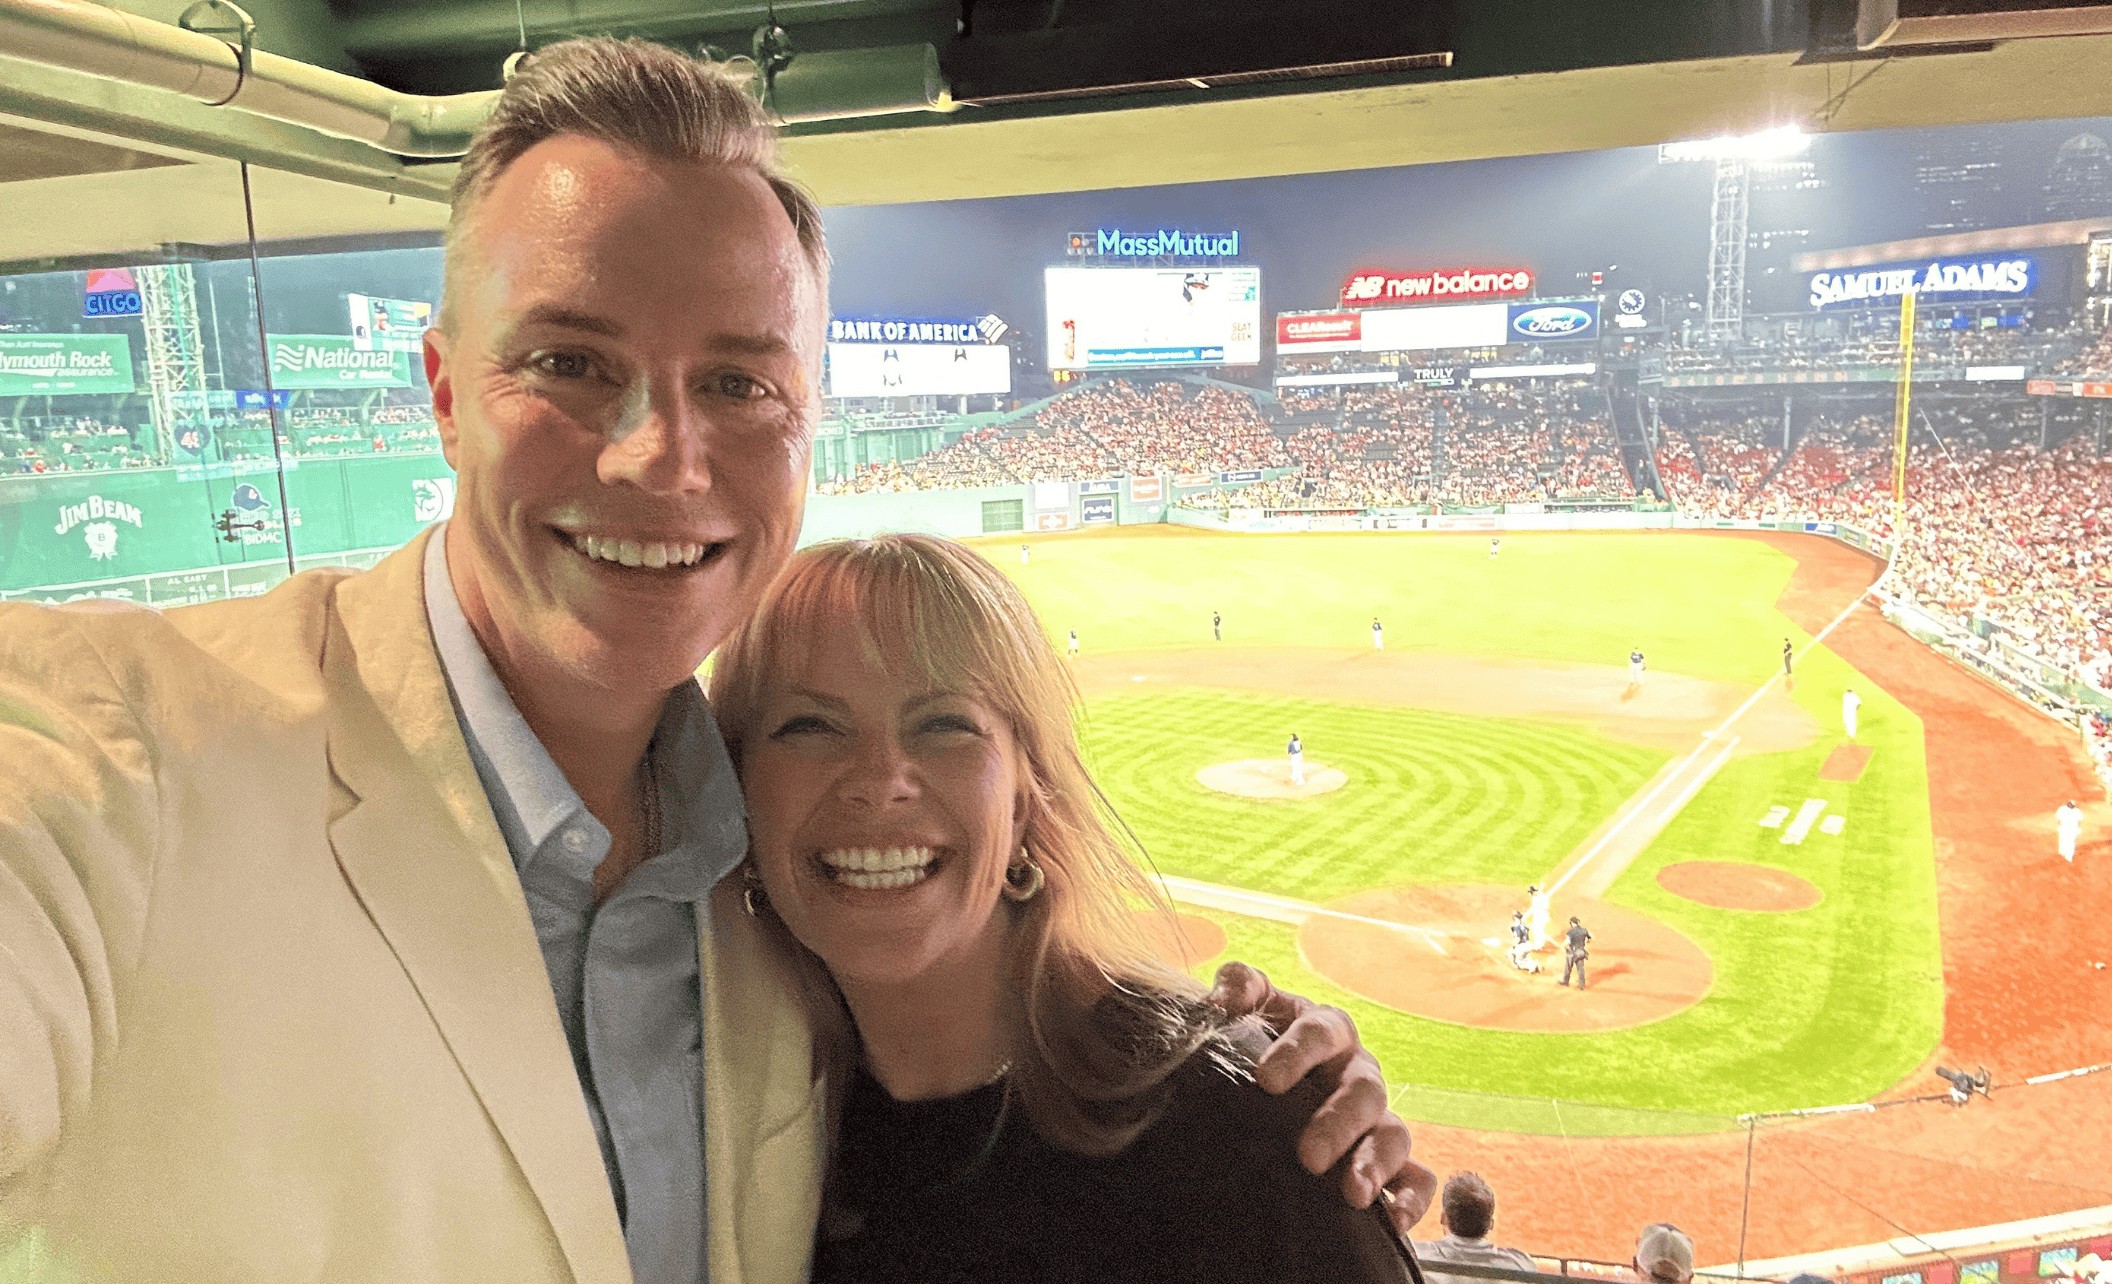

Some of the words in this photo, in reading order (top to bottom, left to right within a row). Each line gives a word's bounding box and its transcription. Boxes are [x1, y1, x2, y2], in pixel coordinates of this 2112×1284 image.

[1097, 229, 1239, 256] MassMutual
[1387, 276, 1432, 297] new
[1433, 270, 1530, 294] balance
[1810, 269, 1921, 307] SAMUEL
[1920, 260, 2029, 294] ADAMS
[87, 292, 141, 314] CITGO
[831, 320, 882, 340] BANK
[884, 321, 907, 341] OF
[908, 323, 979, 342] AMERICA
[1528, 314, 1575, 332] Ford
[0, 351, 66, 370] lymouth
[69, 351, 112, 368] Rock
[304, 346, 394, 368] National
[1413, 367, 1454, 379] TRULY
[54, 502, 89, 535] JIM
[88, 495, 143, 529] BEAM
[244, 531, 283, 545] BIDMC
[167, 578, 181, 586] AL
